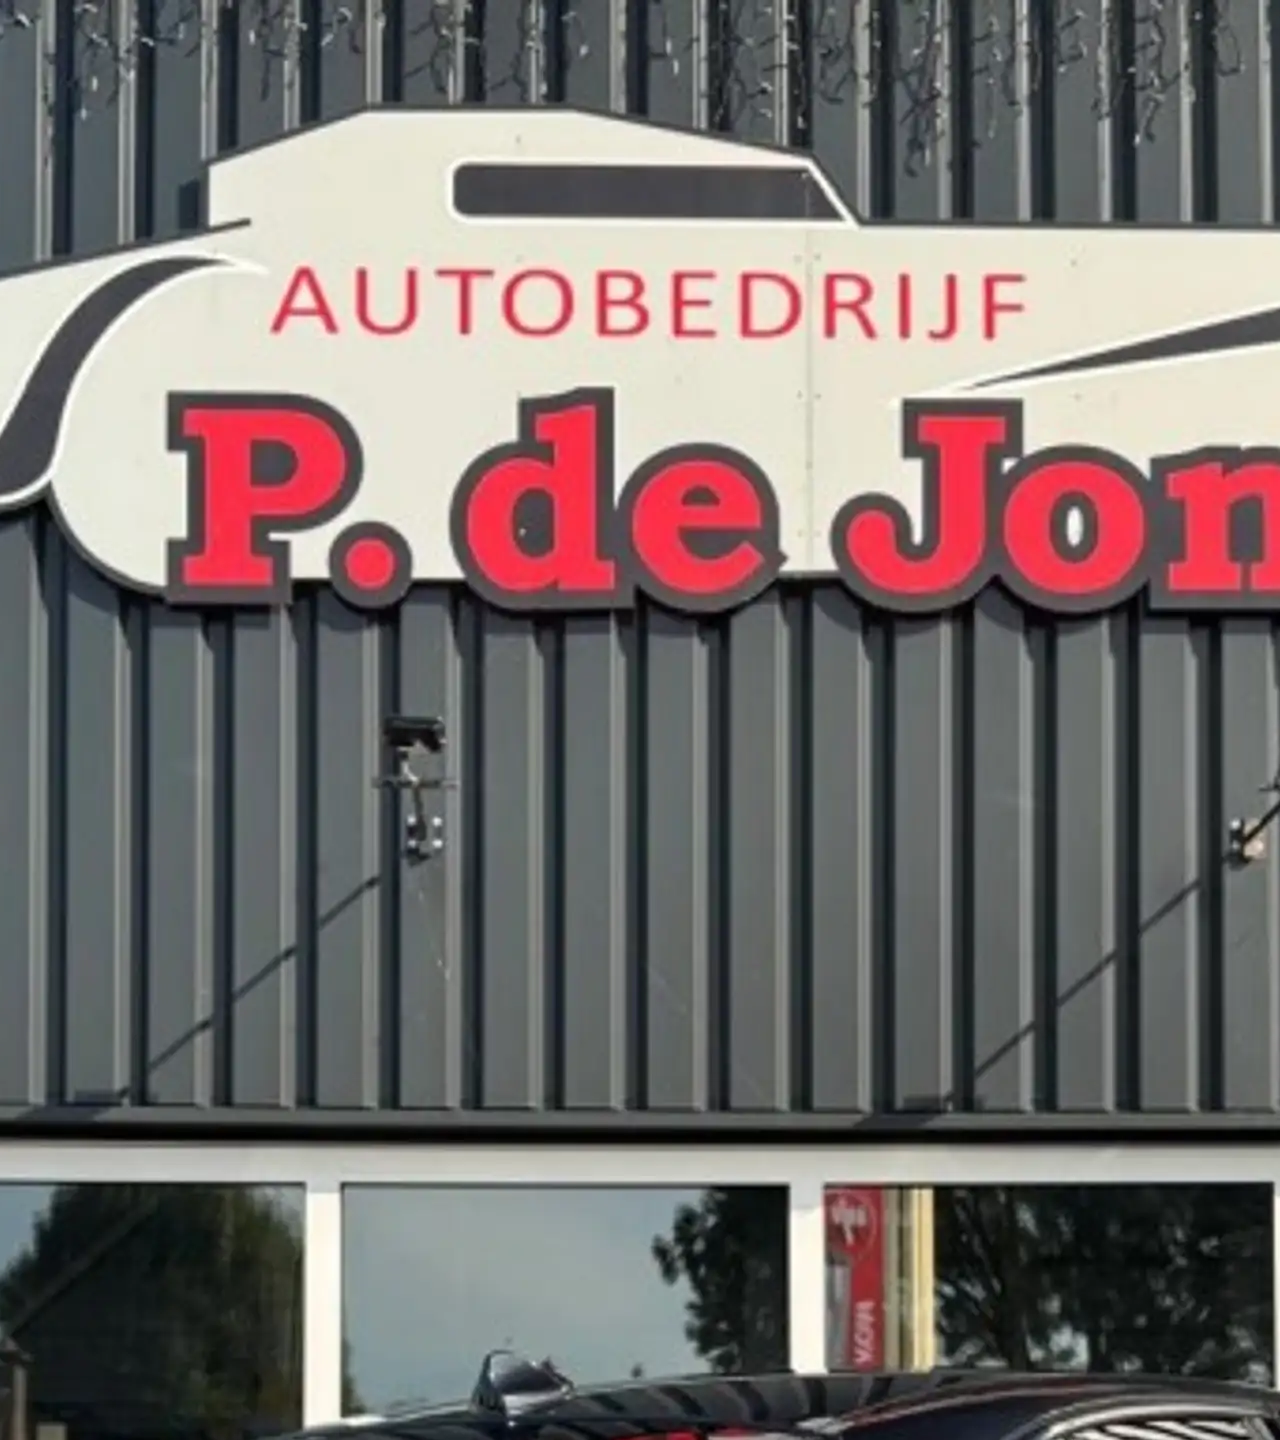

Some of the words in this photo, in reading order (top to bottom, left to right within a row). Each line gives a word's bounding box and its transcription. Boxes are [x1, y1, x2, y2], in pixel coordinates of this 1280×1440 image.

[272, 264, 1026, 342] AUTOBEDRIJF
[172, 398, 406, 598] P.
[458, 396, 773, 603] de
